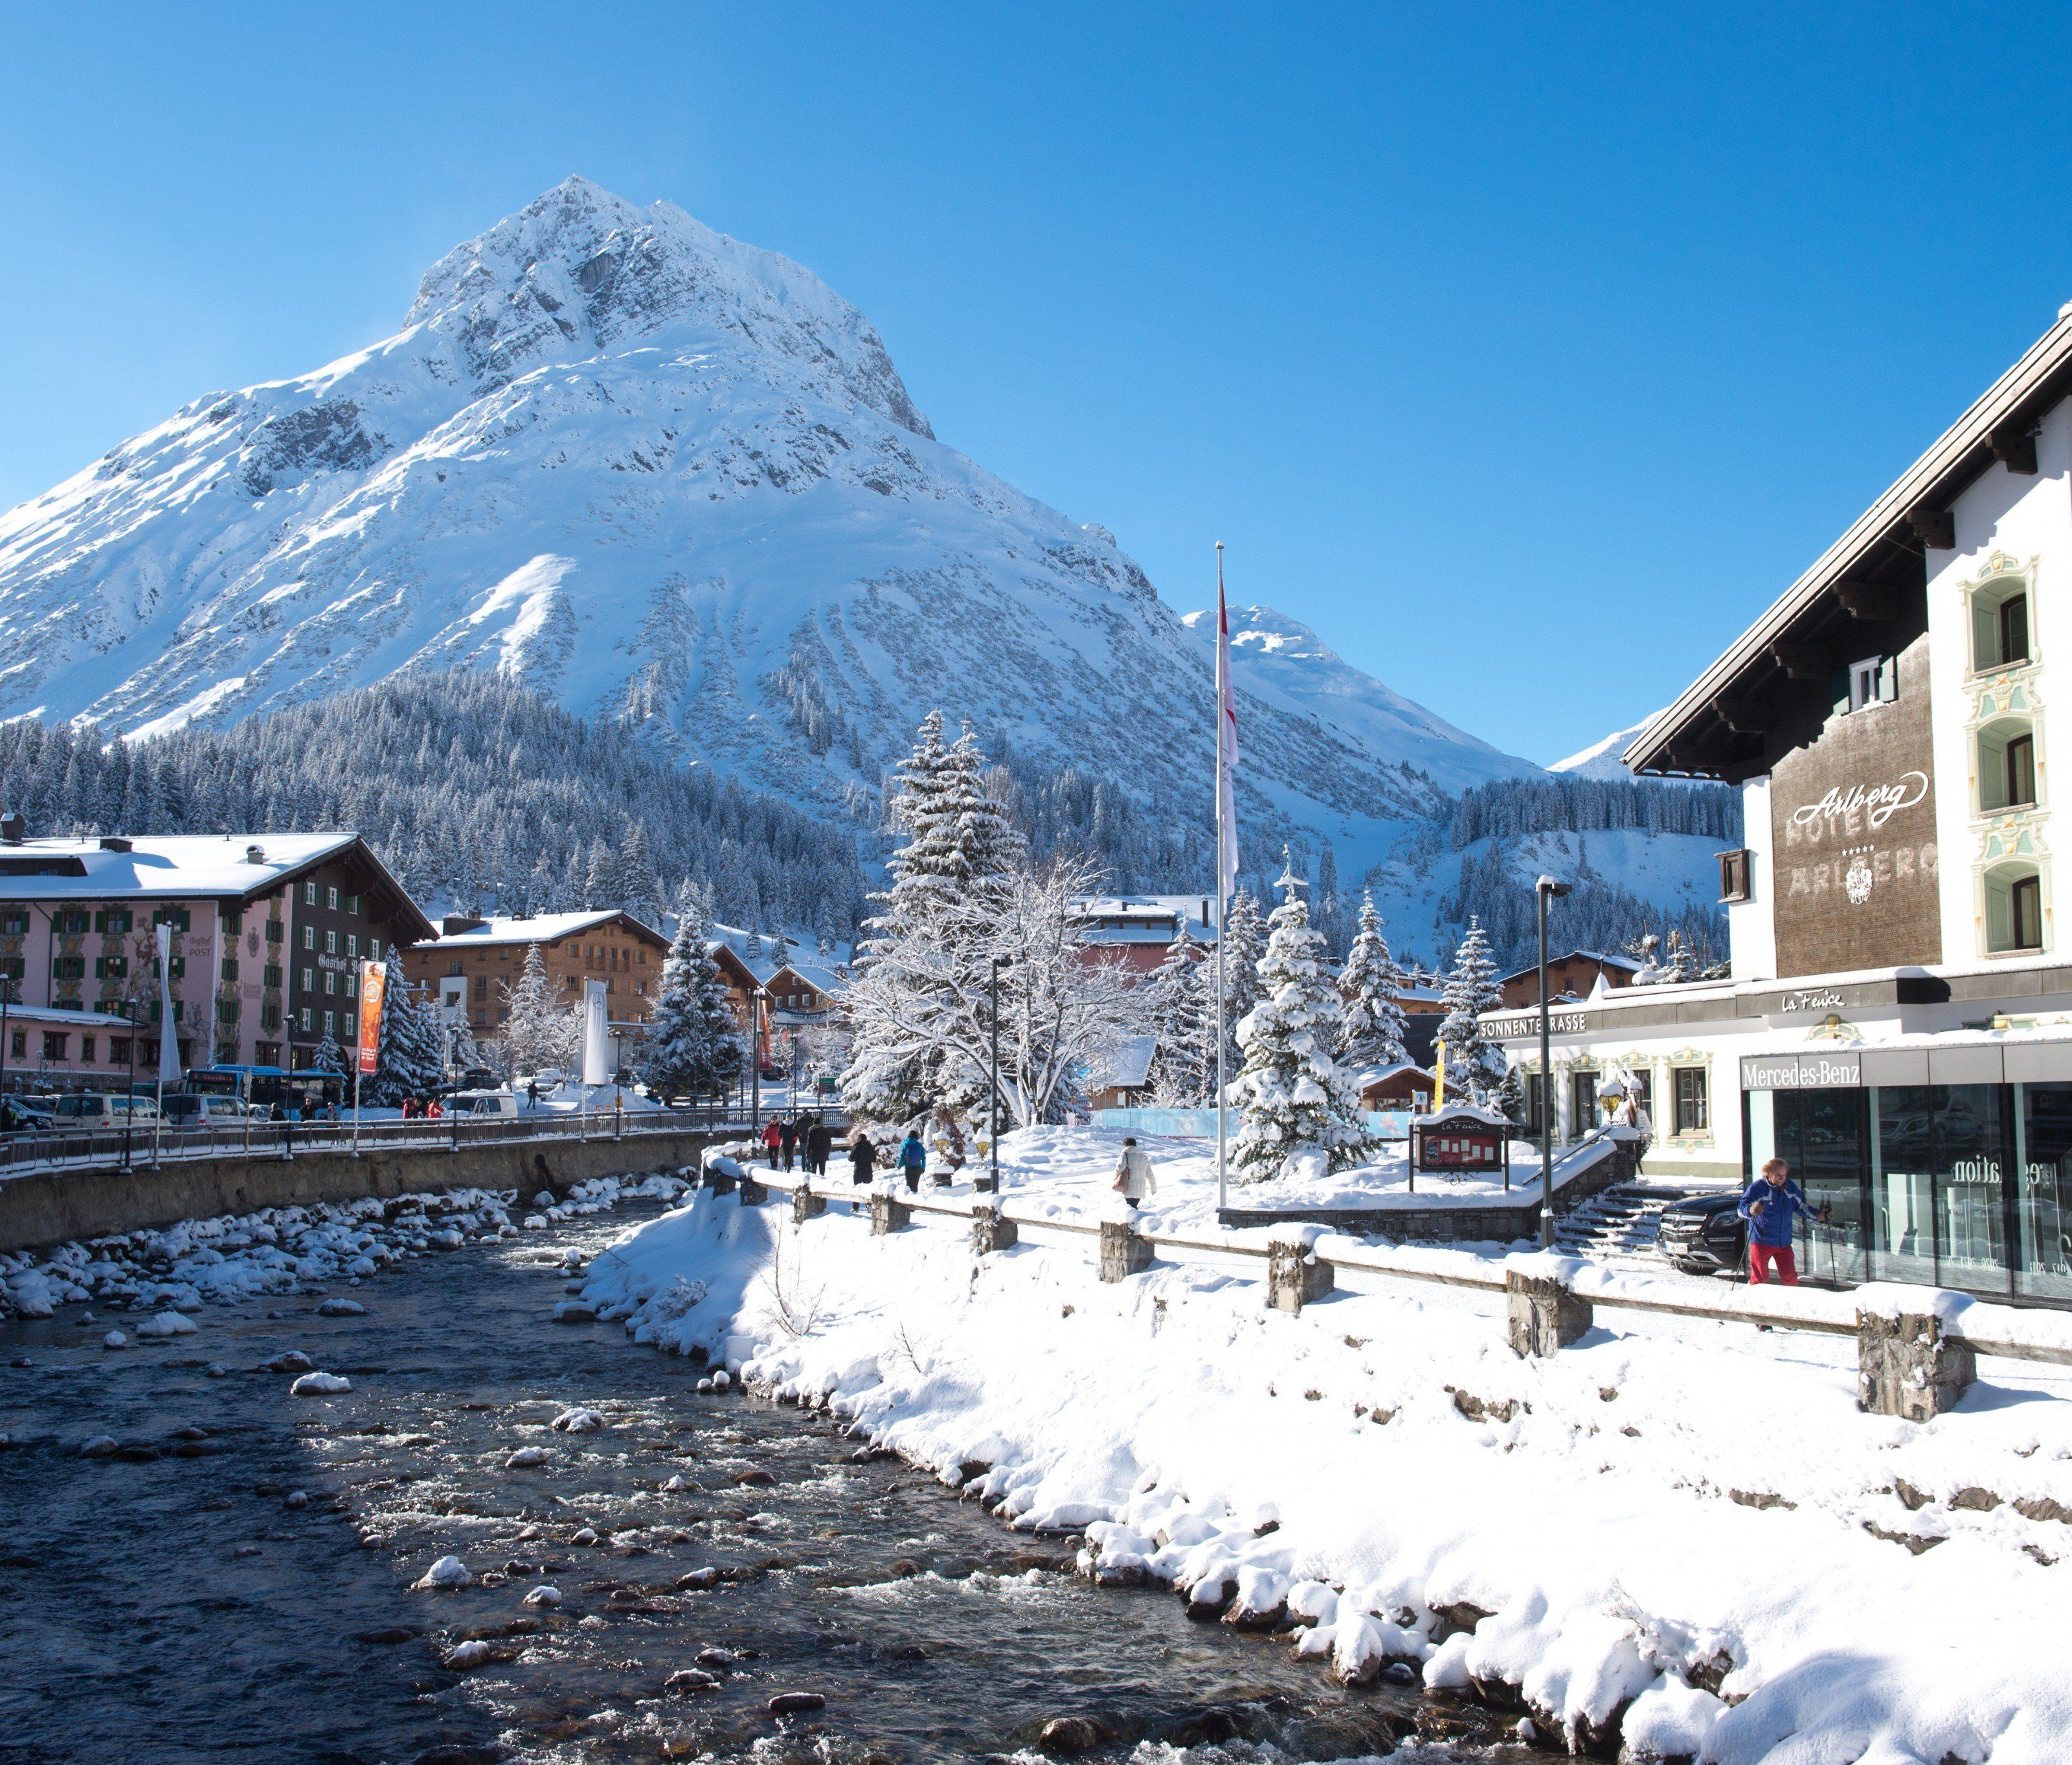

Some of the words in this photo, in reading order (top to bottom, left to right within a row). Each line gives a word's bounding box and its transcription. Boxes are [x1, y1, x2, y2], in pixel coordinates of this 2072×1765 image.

[1794, 770, 1929, 827] Arlberg
[190, 936, 212, 946] Gasthof
[190, 948, 211, 957] POST
[318, 953, 347, 975] Gasthof
[1782, 996, 1797, 1013] La
[1794, 988, 1846, 1010] Fenice
[1481, 1014, 1586, 1037] SONNENTERASSE
[1743, 1060, 1860, 1088] Mercedes-Benz
[1450, 1120, 1483, 1130] Fenice
